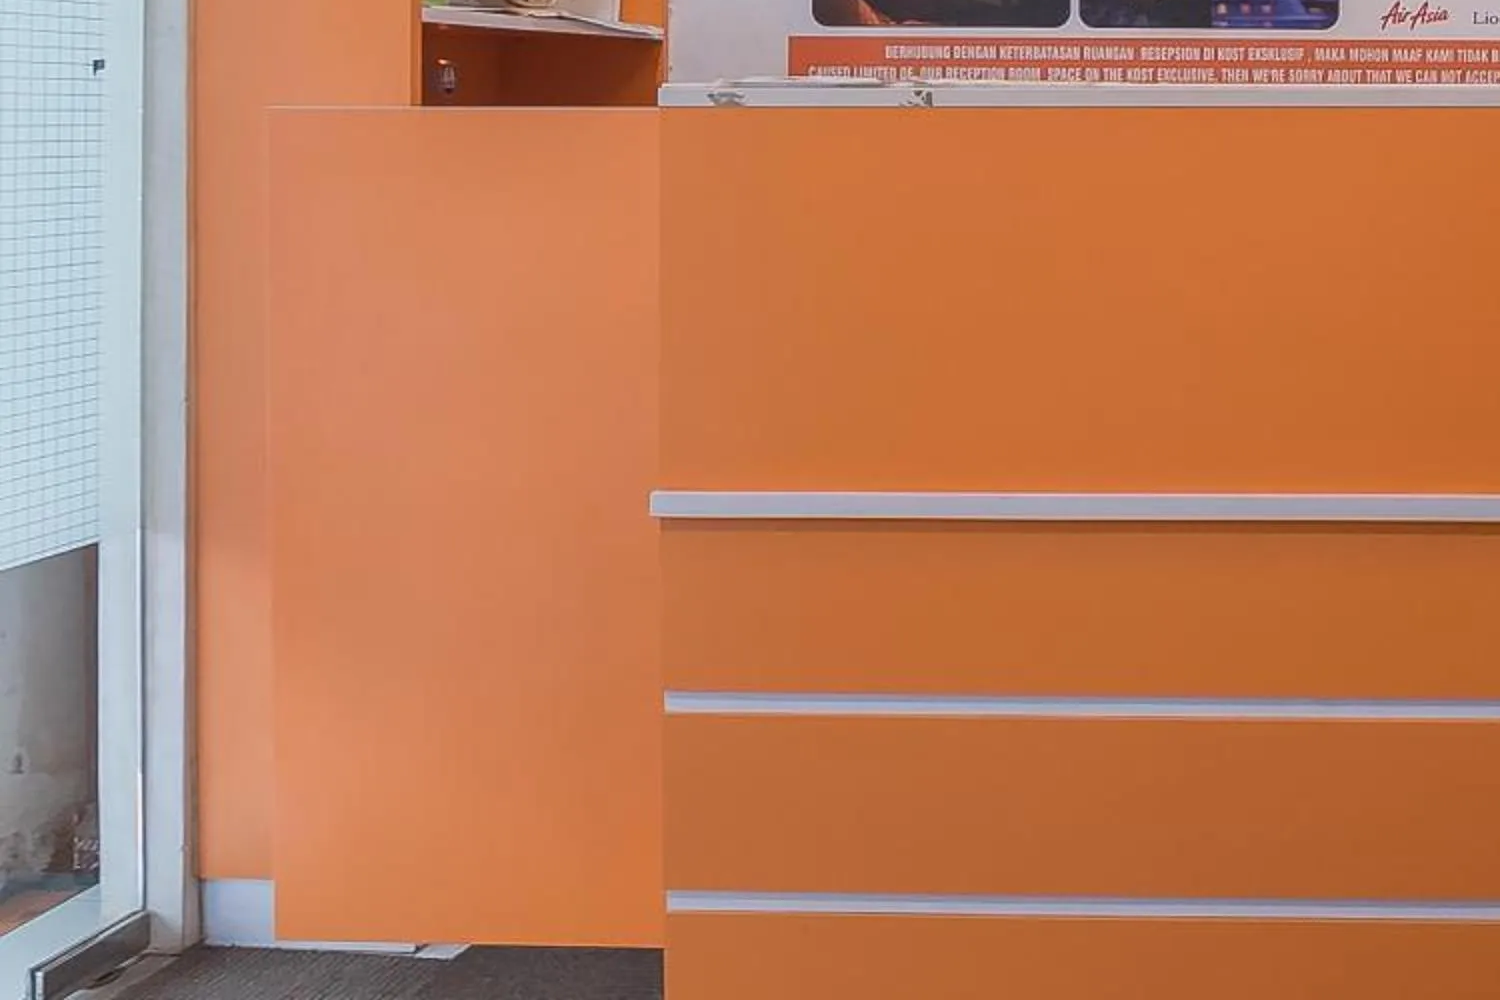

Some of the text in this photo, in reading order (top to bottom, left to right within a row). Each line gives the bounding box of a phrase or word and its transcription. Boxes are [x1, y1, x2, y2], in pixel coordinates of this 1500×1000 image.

[953, 46, 997, 59] DENGAN
[1000, 46, 1081, 60] KETERBATASAN
[1203, 47, 1215, 61] DI
[1218, 47, 1245, 61] KOST
[1314, 48, 1346, 62] MAKA
[1392, 49, 1423, 63] MAAF
[1457, 49, 1489, 63] TIDAK
[1103, 68, 1124, 81] THE
[1221, 68, 1249, 82] THEN
[1288, 69, 1323, 83] SORRY
[1365, 69, 1393, 83] THAT
[1396, 70, 1413, 83] WE
[1415, 70, 1438, 84] CAN
